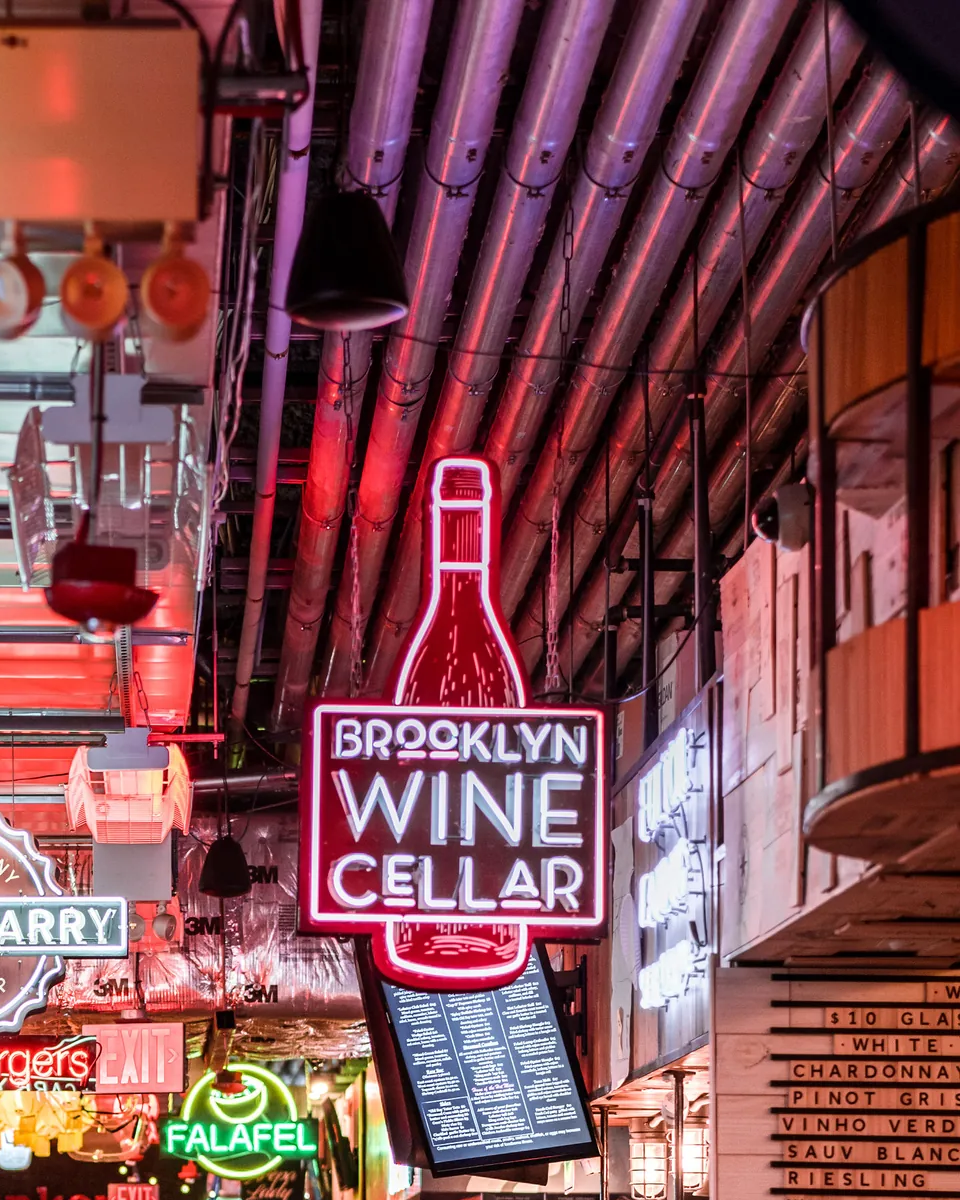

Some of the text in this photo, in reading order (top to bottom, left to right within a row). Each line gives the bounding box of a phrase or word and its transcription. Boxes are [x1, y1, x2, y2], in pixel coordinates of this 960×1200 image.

[334, 717, 587, 763] BROOKLYN
[332, 768, 585, 847] WINE
[249, 866, 278, 884] 3M
[328, 852, 585, 913] CELLAR
[185, 917, 221, 935] 3M
[94, 978, 128, 997] 3M
[244, 985, 278, 1003] 3M
[830, 1011, 877, 1025] $10
[852, 1037, 938, 1053] WHITE
[99, 1029, 171, 1086] EXIT
[793, 1091, 876, 1105] PINOT
[782, 1117, 866, 1132] VINHO
[167, 1122, 317, 1152] FALAFEL
[788, 1145, 960, 1161] SAUV BLANC
[788, 1171, 926, 1187] RIESLING
